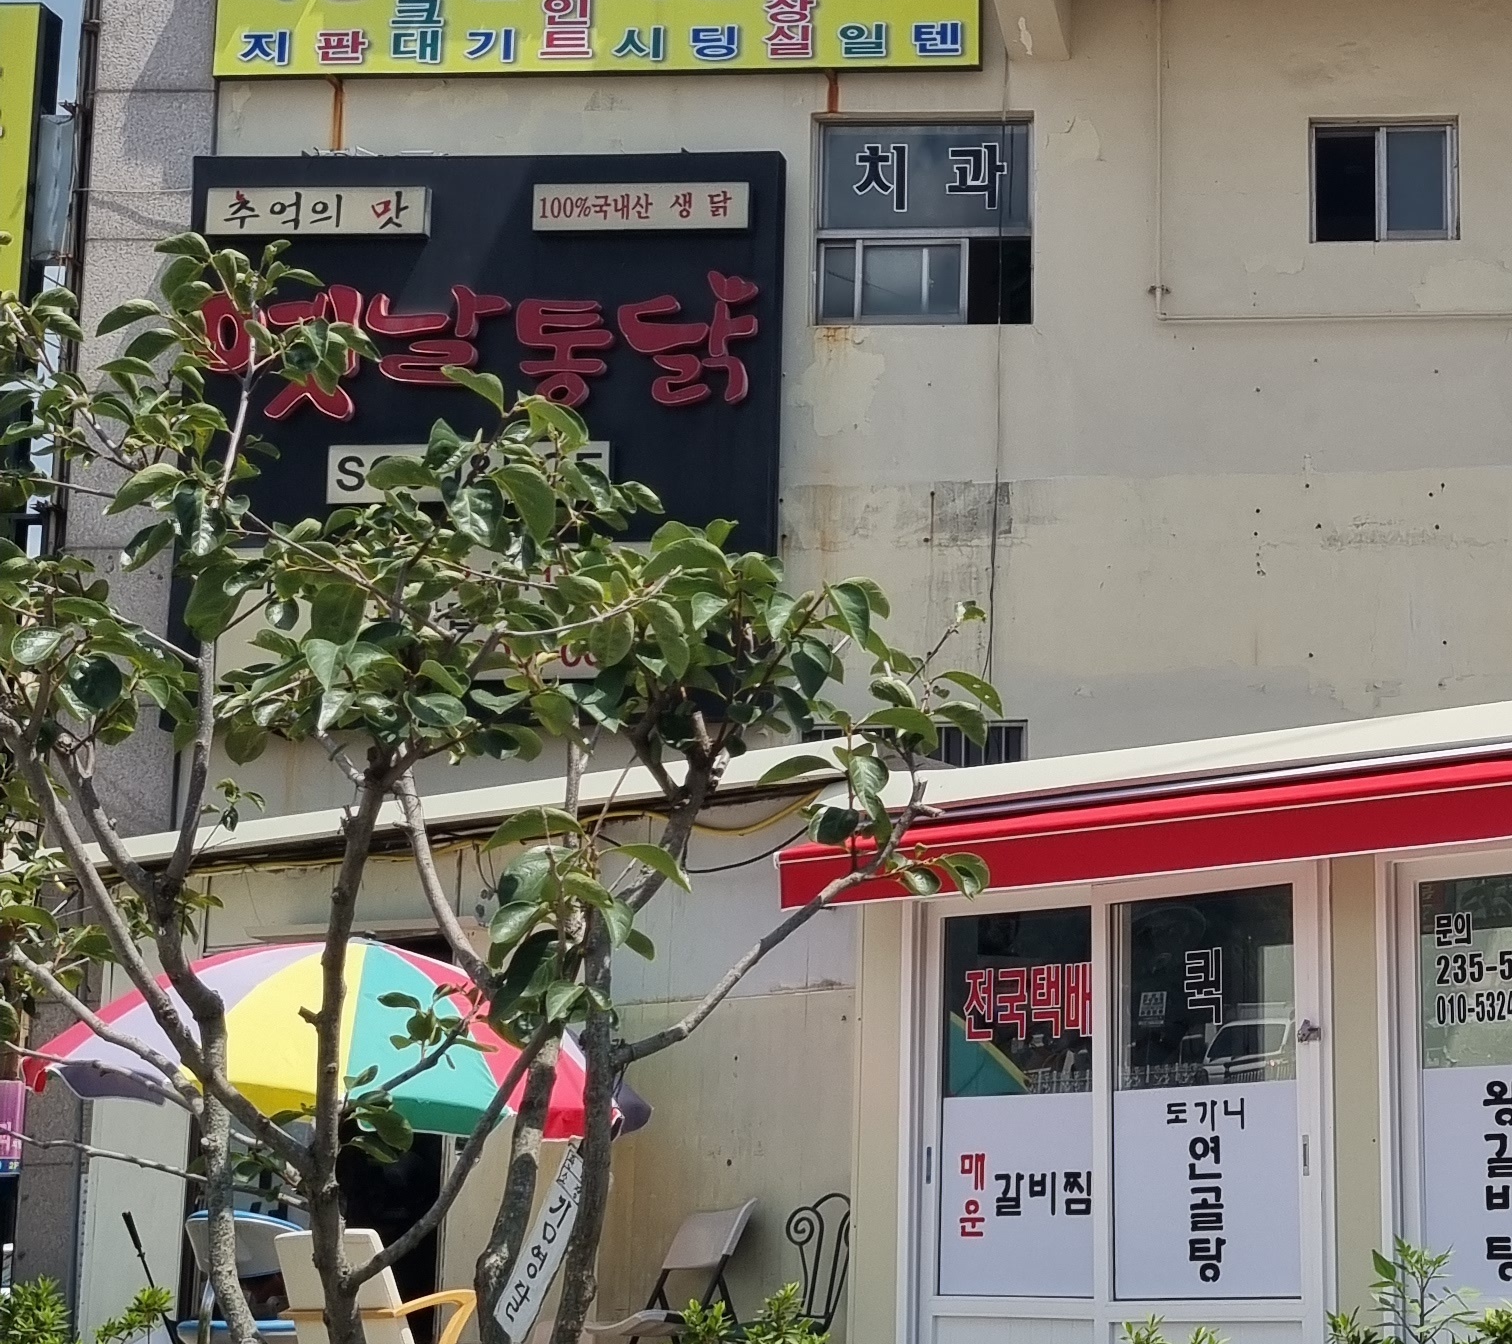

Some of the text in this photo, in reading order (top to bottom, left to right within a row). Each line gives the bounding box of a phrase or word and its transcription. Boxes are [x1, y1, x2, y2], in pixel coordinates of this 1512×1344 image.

[224, 190, 409, 230] 추억의 맛
[539, 192, 653, 221] 100%국내산
[1434, 911, 1473, 948] 문의
[963, 961, 1093, 1042] 전국택배
[1165, 1097, 1247, 1130] 도가니
[959, 1152, 1092, 1238] 매운 갈비찜
[1187, 1135, 1227, 1283] 연골탕
